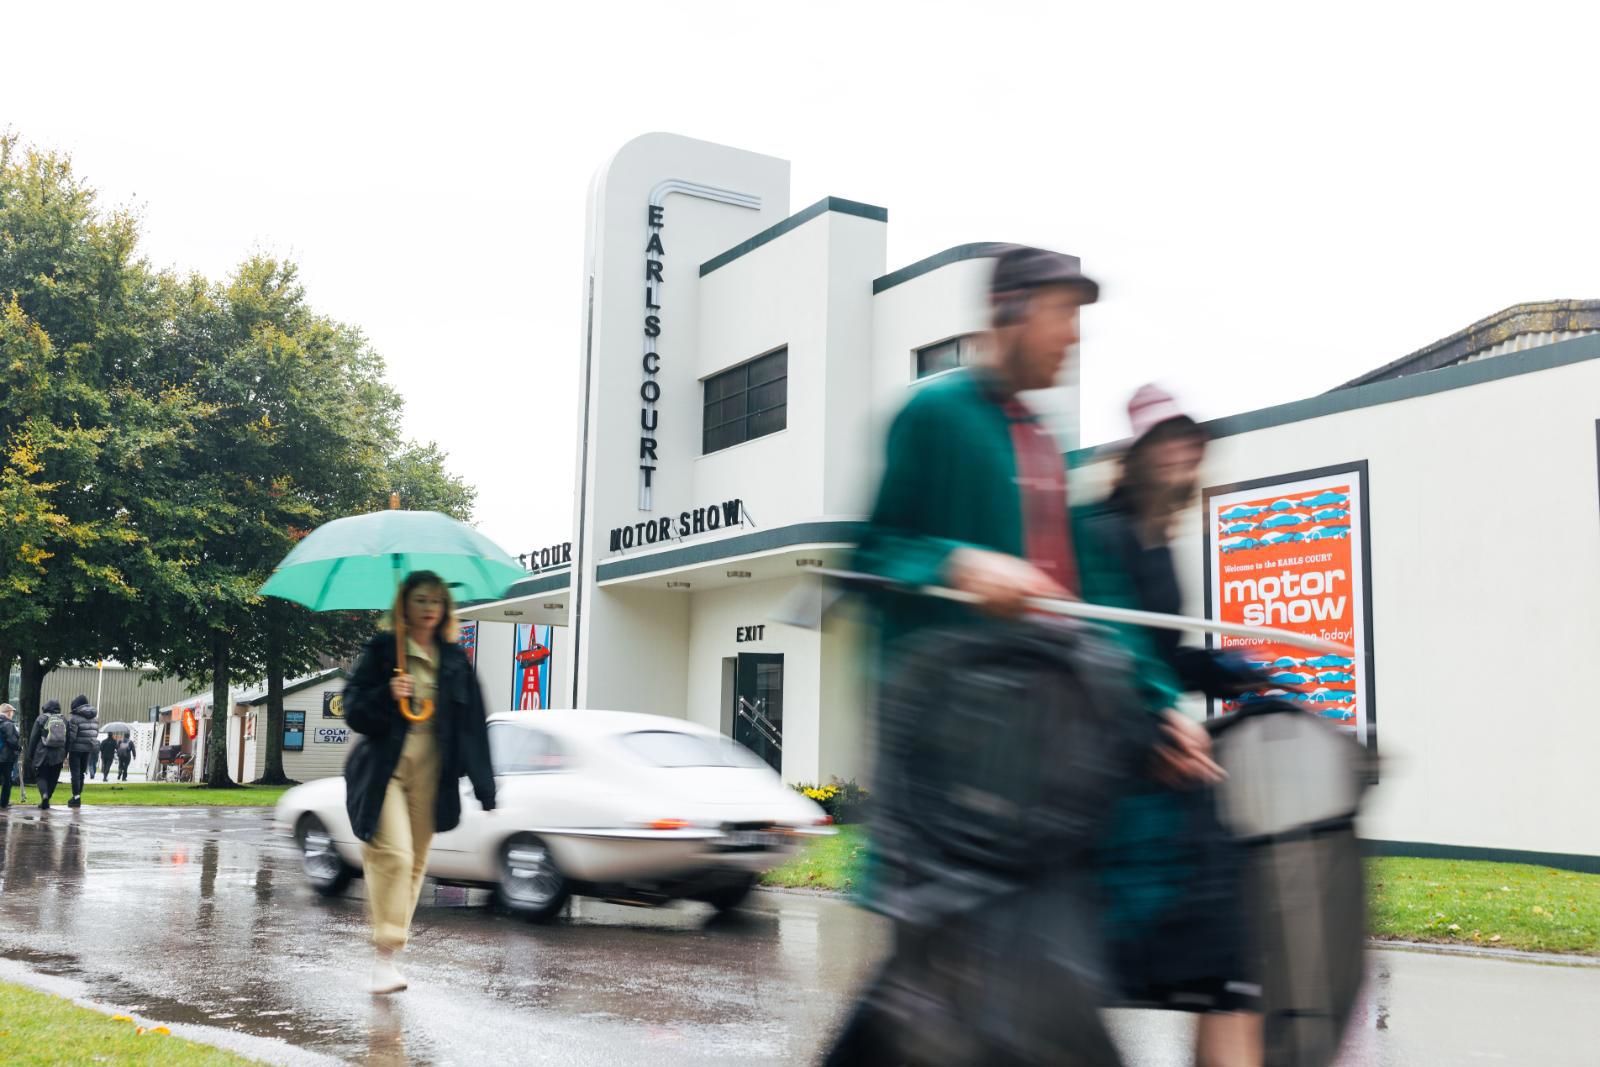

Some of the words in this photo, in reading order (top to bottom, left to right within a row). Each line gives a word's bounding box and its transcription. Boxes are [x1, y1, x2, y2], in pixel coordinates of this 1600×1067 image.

[645, 204, 665, 338] EARLS
[640, 352, 661, 488] COURT
[610, 516, 671, 552] MOTOR
[679, 498, 742, 537] SHOW
[1224, 564, 1255, 573] Welcome
[1255, 562, 1263, 570] to
[1264, 559, 1276, 569] the
[1277, 556, 1304, 567] EARLS
[1304, 553, 1333, 563] COURT
[1224, 569, 1346, 604] motor
[1243, 596, 1347, 626] show
[736, 624, 766, 643] EXIT
[1223, 635, 1272, 647] Tomorrows
[1319, 627, 1353, 643] Today!
